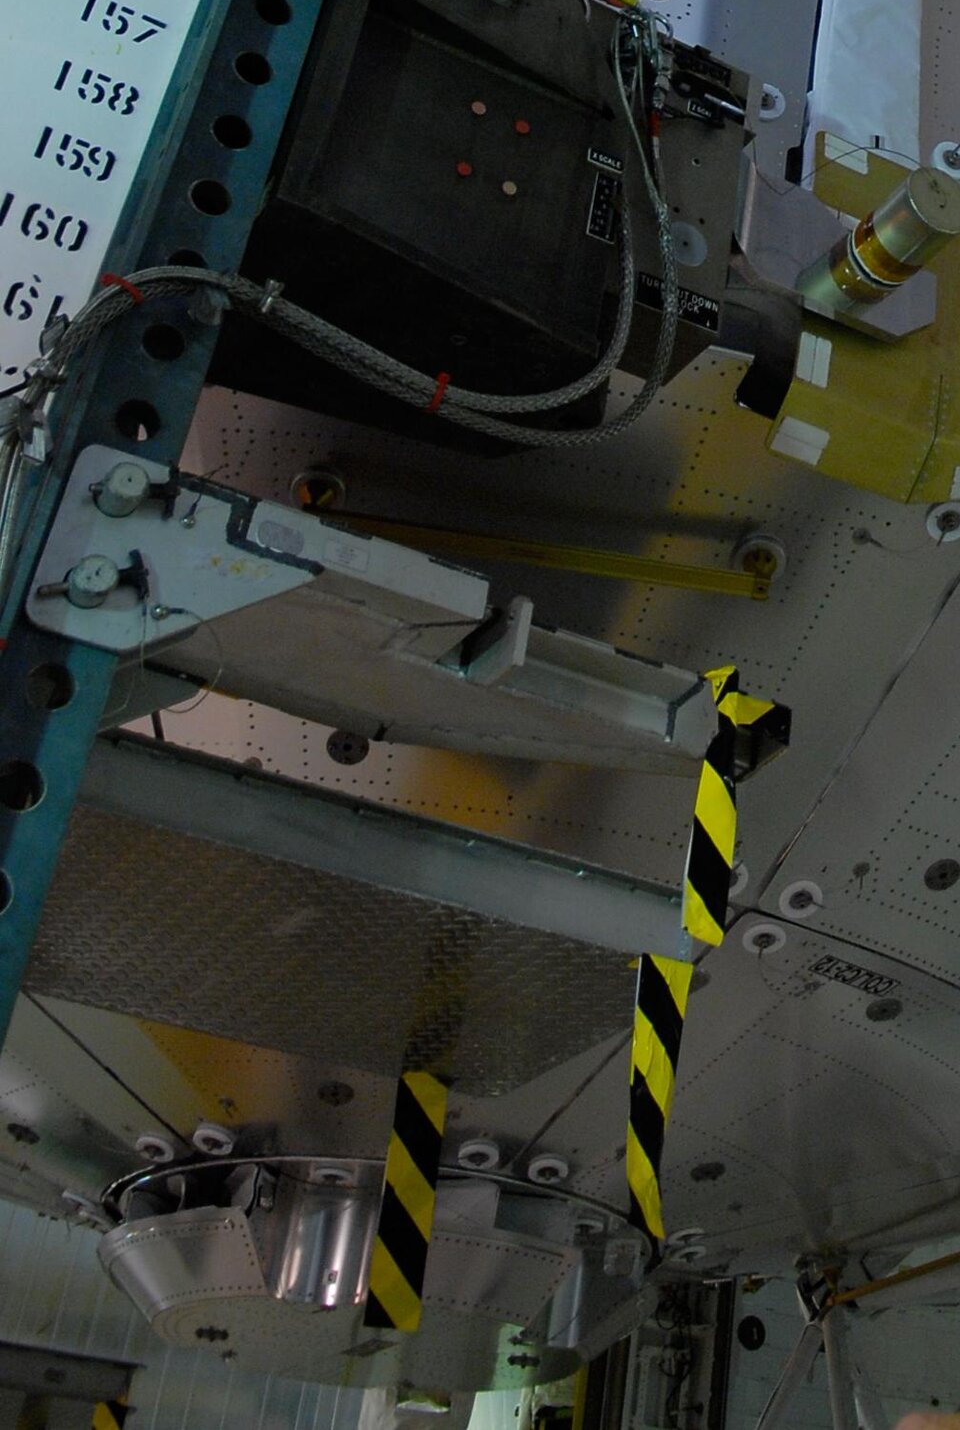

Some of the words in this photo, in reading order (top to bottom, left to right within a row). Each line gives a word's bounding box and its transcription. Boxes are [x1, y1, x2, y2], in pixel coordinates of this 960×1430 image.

[54, 60, 139, 115] 158
[34, 126, 116, 181] 159
[0, 192, 88, 251] 160
[3, 281, 64, 328] 61
[691, 294, 719, 312] DOWN
